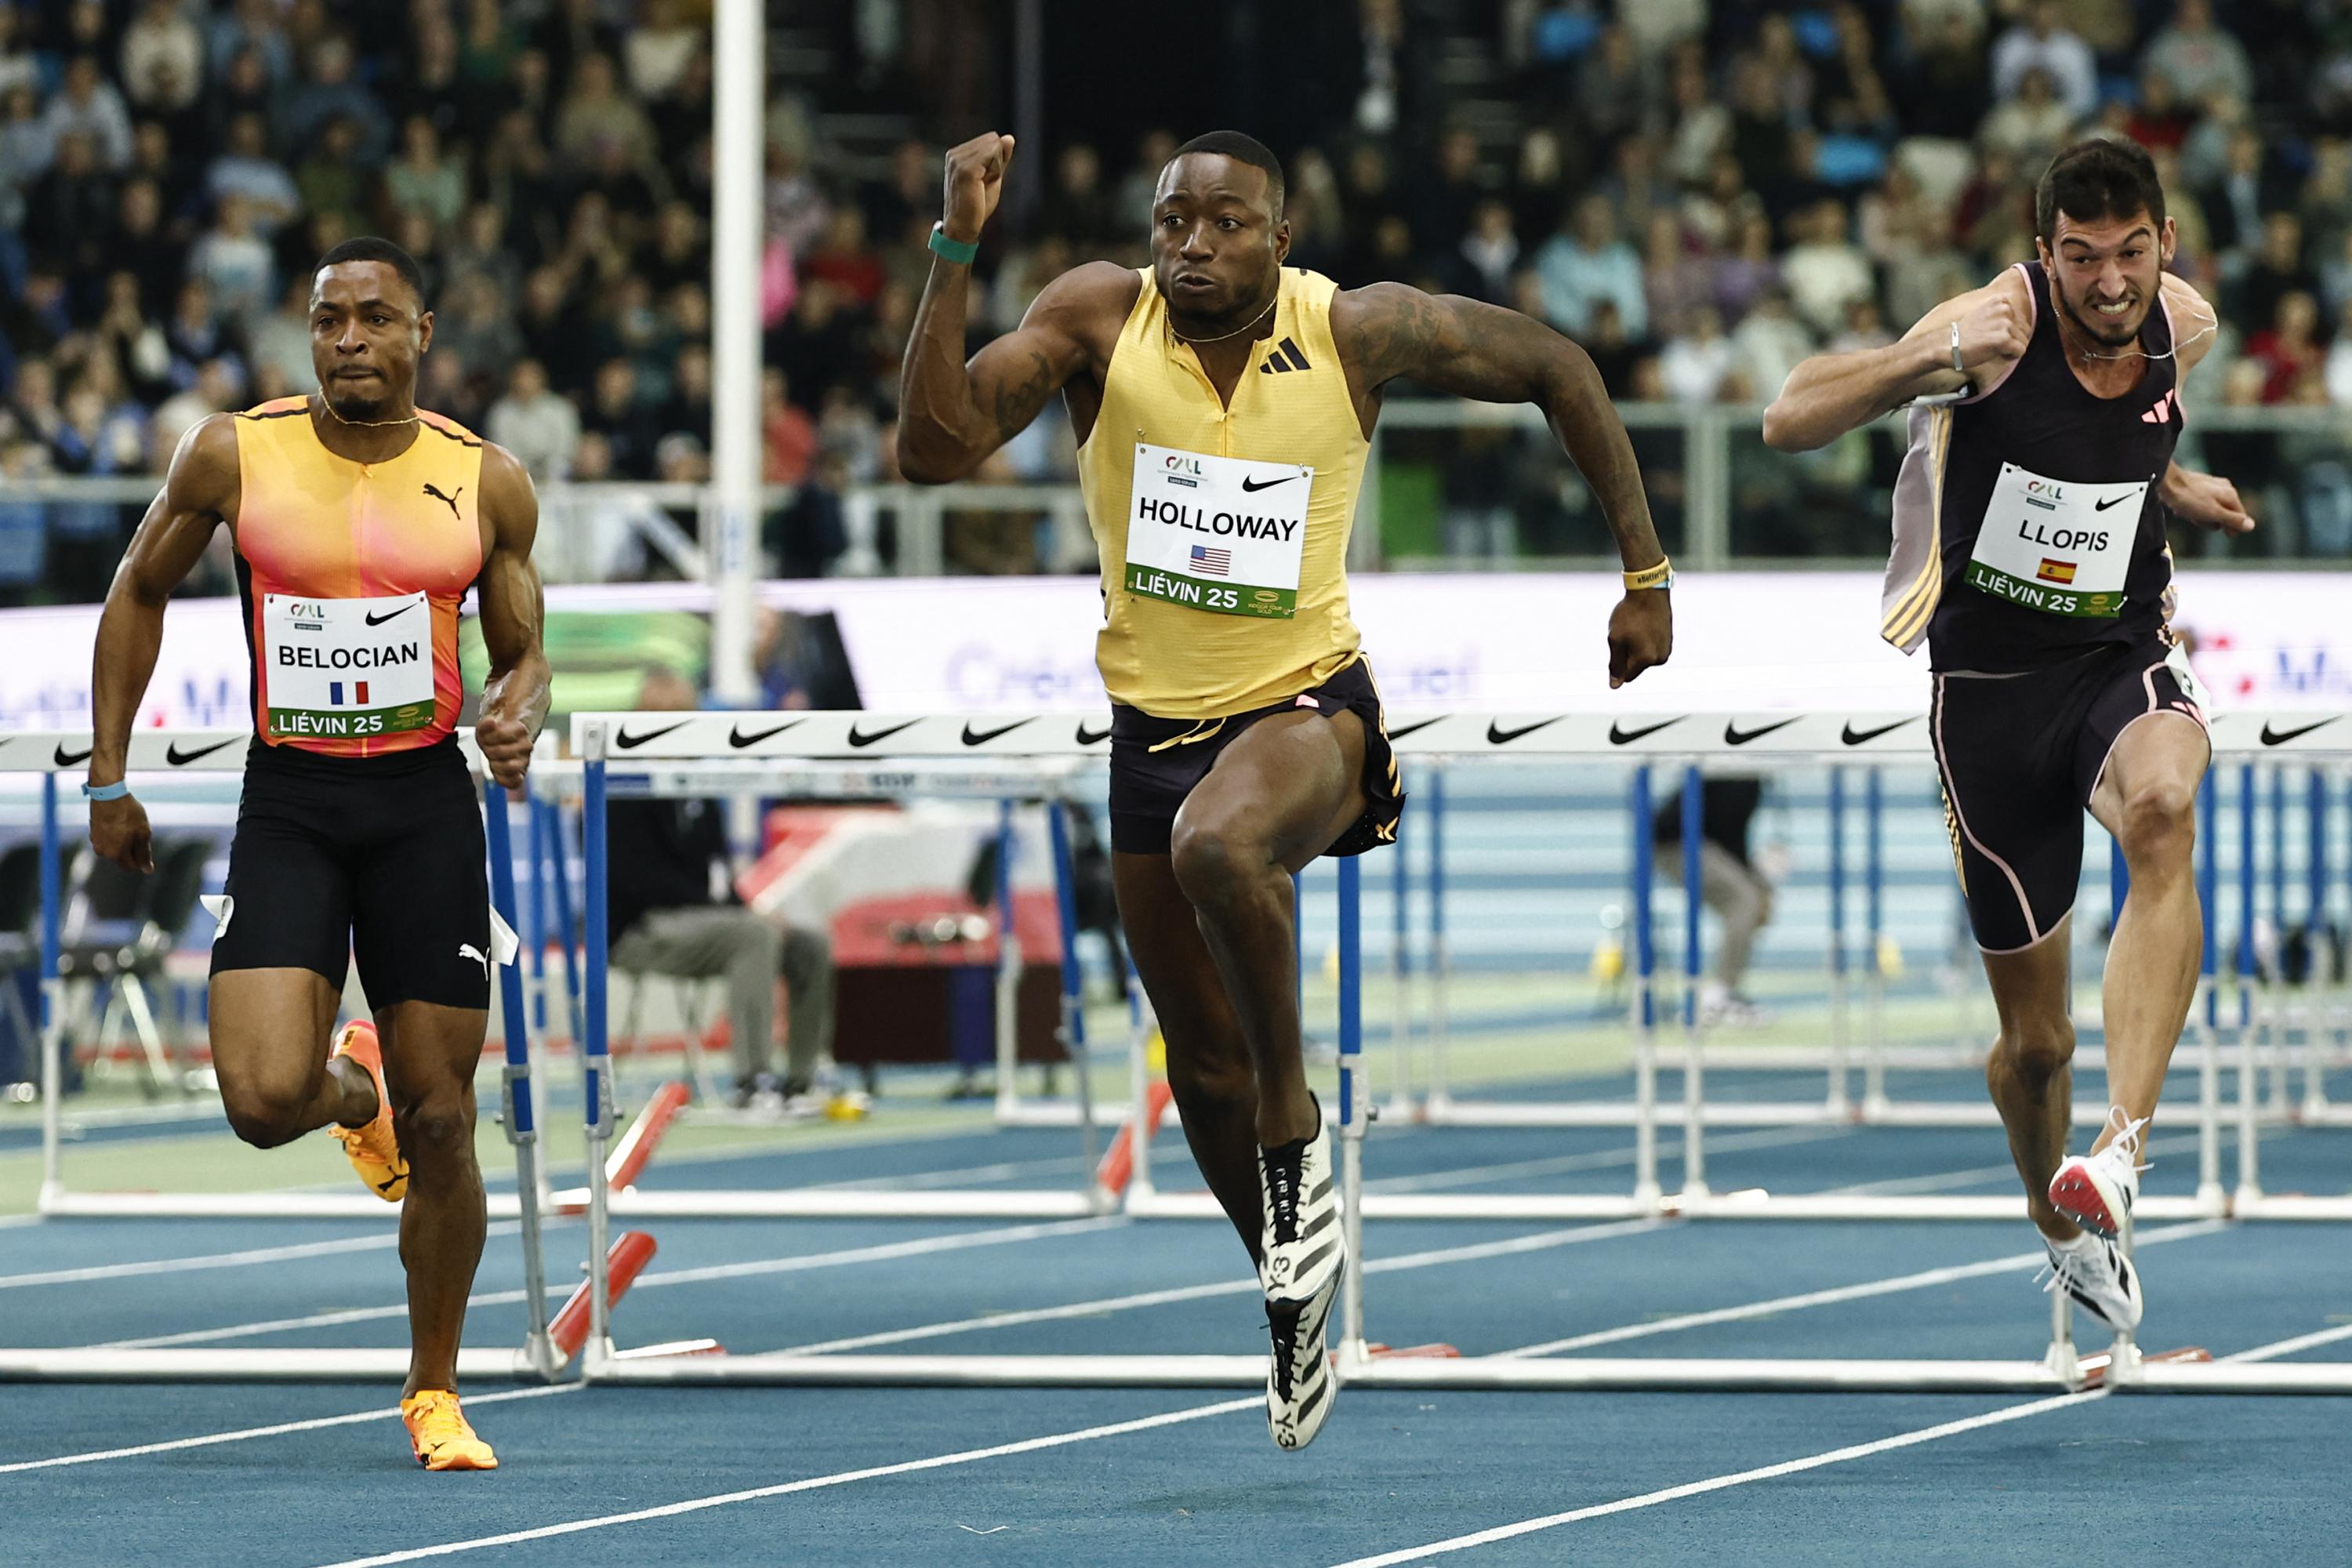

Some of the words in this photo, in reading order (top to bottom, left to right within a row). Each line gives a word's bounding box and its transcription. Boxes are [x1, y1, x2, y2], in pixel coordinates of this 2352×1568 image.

[1139, 497, 1298, 542] HOLLOWAY
[2018, 519, 2109, 551] LLOPIS
[1136, 572, 1200, 603] LIÉVIN
[1206, 588, 1238, 608] 25
[1976, 569, 2045, 607] LIÉVIN
[2048, 594, 2078, 612] 25
[278, 641, 419, 669] BELOCIAN
[279, 712, 347, 734] LIÉVIN
[354, 715, 383, 732] 25
